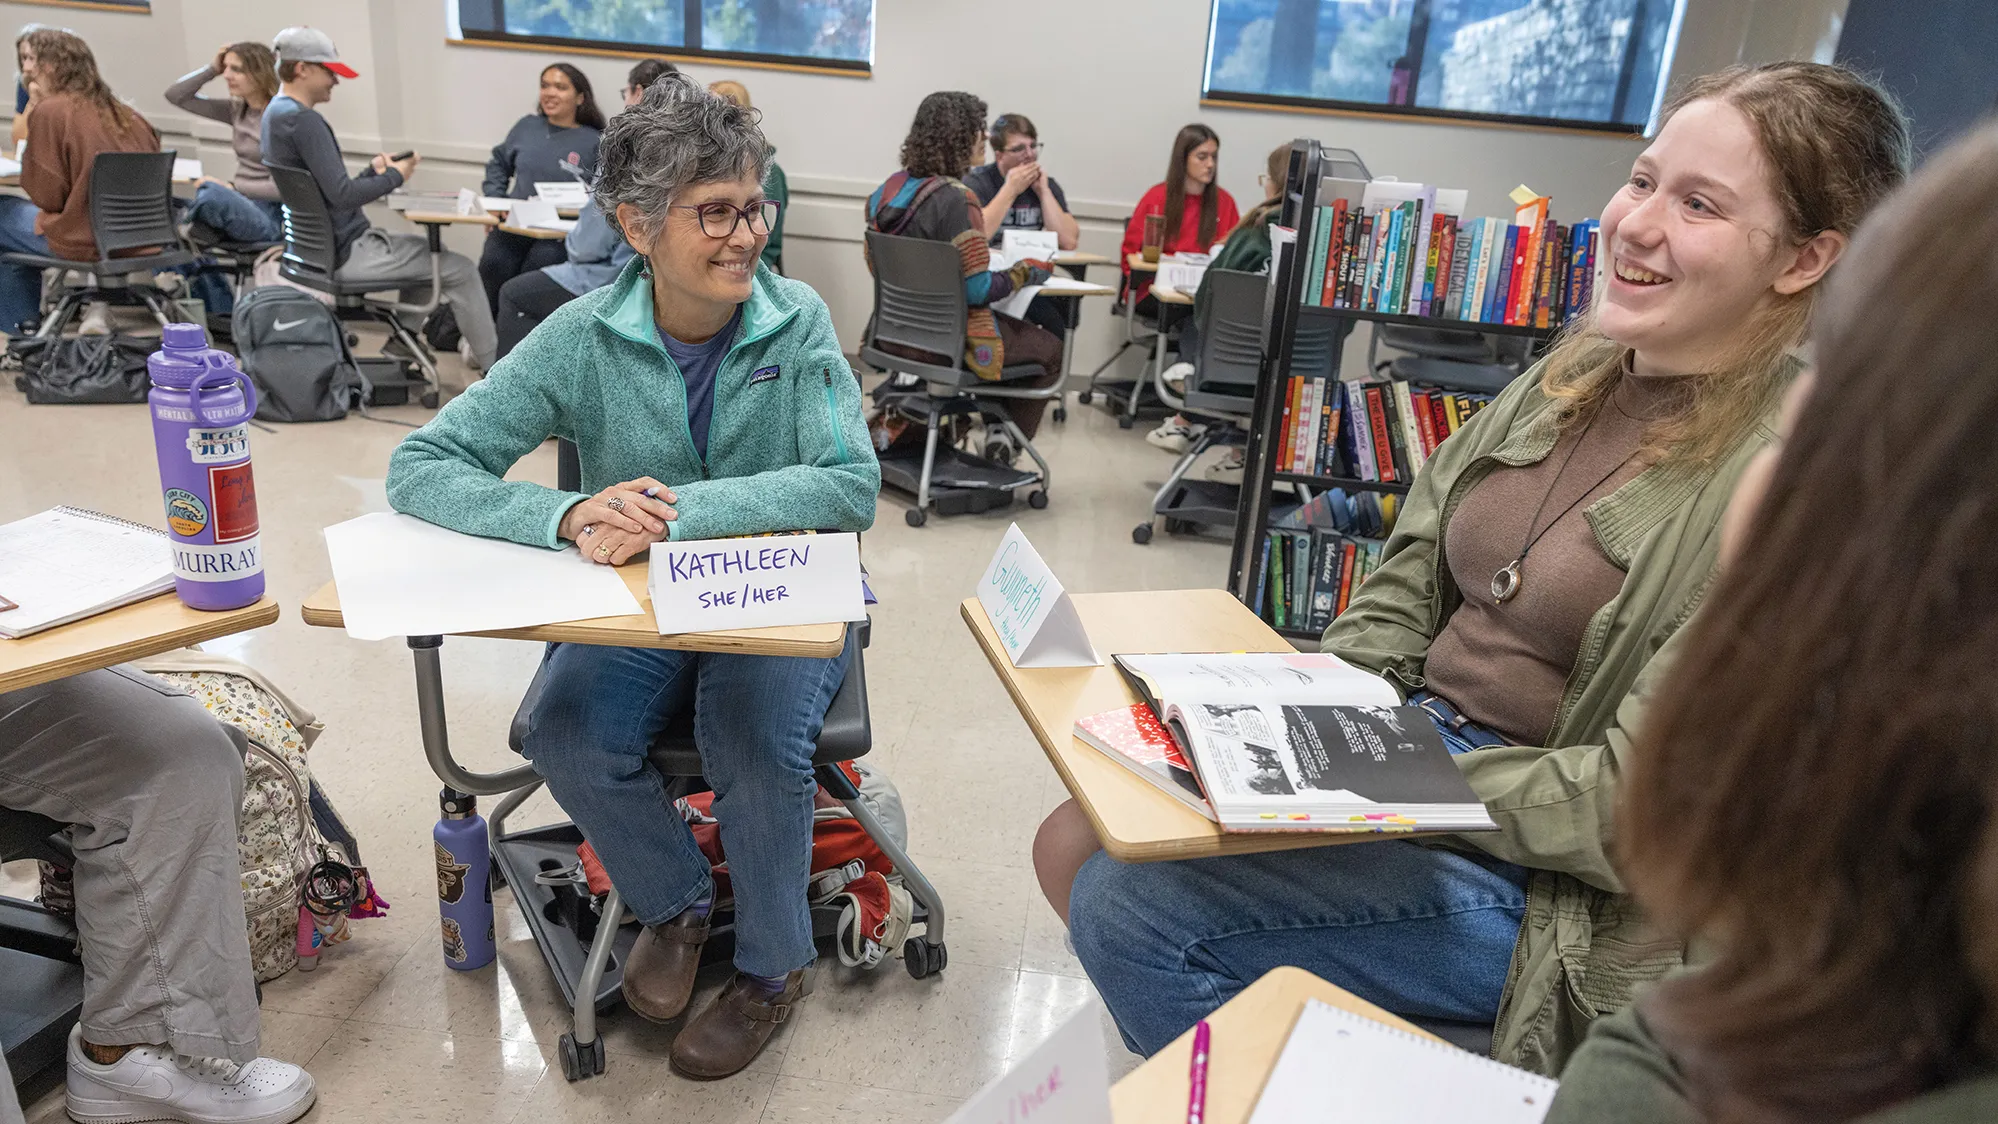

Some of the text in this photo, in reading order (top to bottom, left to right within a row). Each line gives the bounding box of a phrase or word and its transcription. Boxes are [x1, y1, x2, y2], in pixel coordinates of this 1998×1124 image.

[1433, 217, 1442, 232] THIS
[1430, 234, 1440, 256] BOOK
[1338, 251, 1349, 281] SHOUT
[1426, 266, 1435, 281] GAY
[1446, 235, 1474, 297] IDENTICAL
[157, 408, 188, 421] MENTAL
[190, 409, 222, 421] HALTH
[1371, 397, 1381, 414] THE
[1458, 399, 1471, 424] FL
[1374, 416, 1384, 438] HATE
[1433, 400, 1449, 440] CONCRE
[196, 430, 247, 455] JESUS
[1379, 449, 1389, 470] GIVE
[179, 491, 196, 502] CITY
[173, 546, 257, 574] MURRAY
[669, 544, 811, 583] KATHLEEN
[1321, 542, 1337, 584] Blankets
[698, 583, 789, 609] SHE/HER
[992, 540, 1047, 630] Gwyneth
